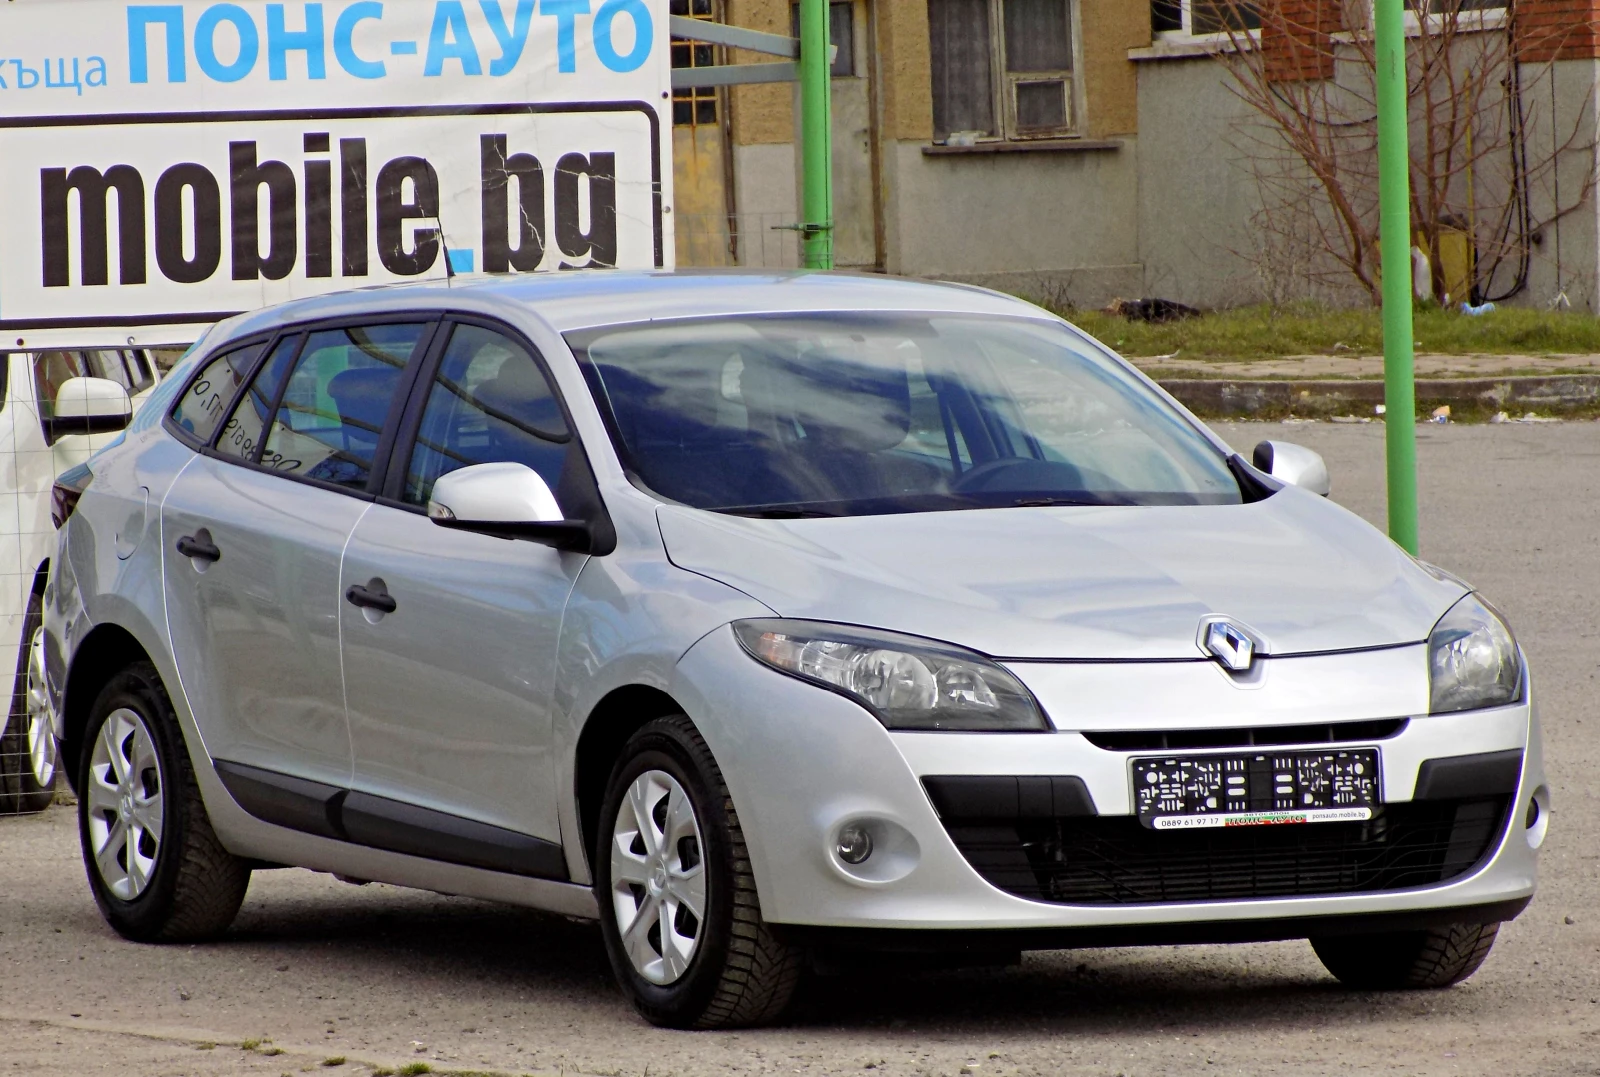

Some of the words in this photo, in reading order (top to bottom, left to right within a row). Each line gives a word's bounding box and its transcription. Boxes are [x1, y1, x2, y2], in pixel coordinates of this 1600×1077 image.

[127, 0, 654, 85] ПОНС-АУТО
[40, 131, 618, 287] mobile.bg
[1161, 819, 1182, 827] 0889
[1312, 811, 1366, 820] ponsauto.mobile.bg
